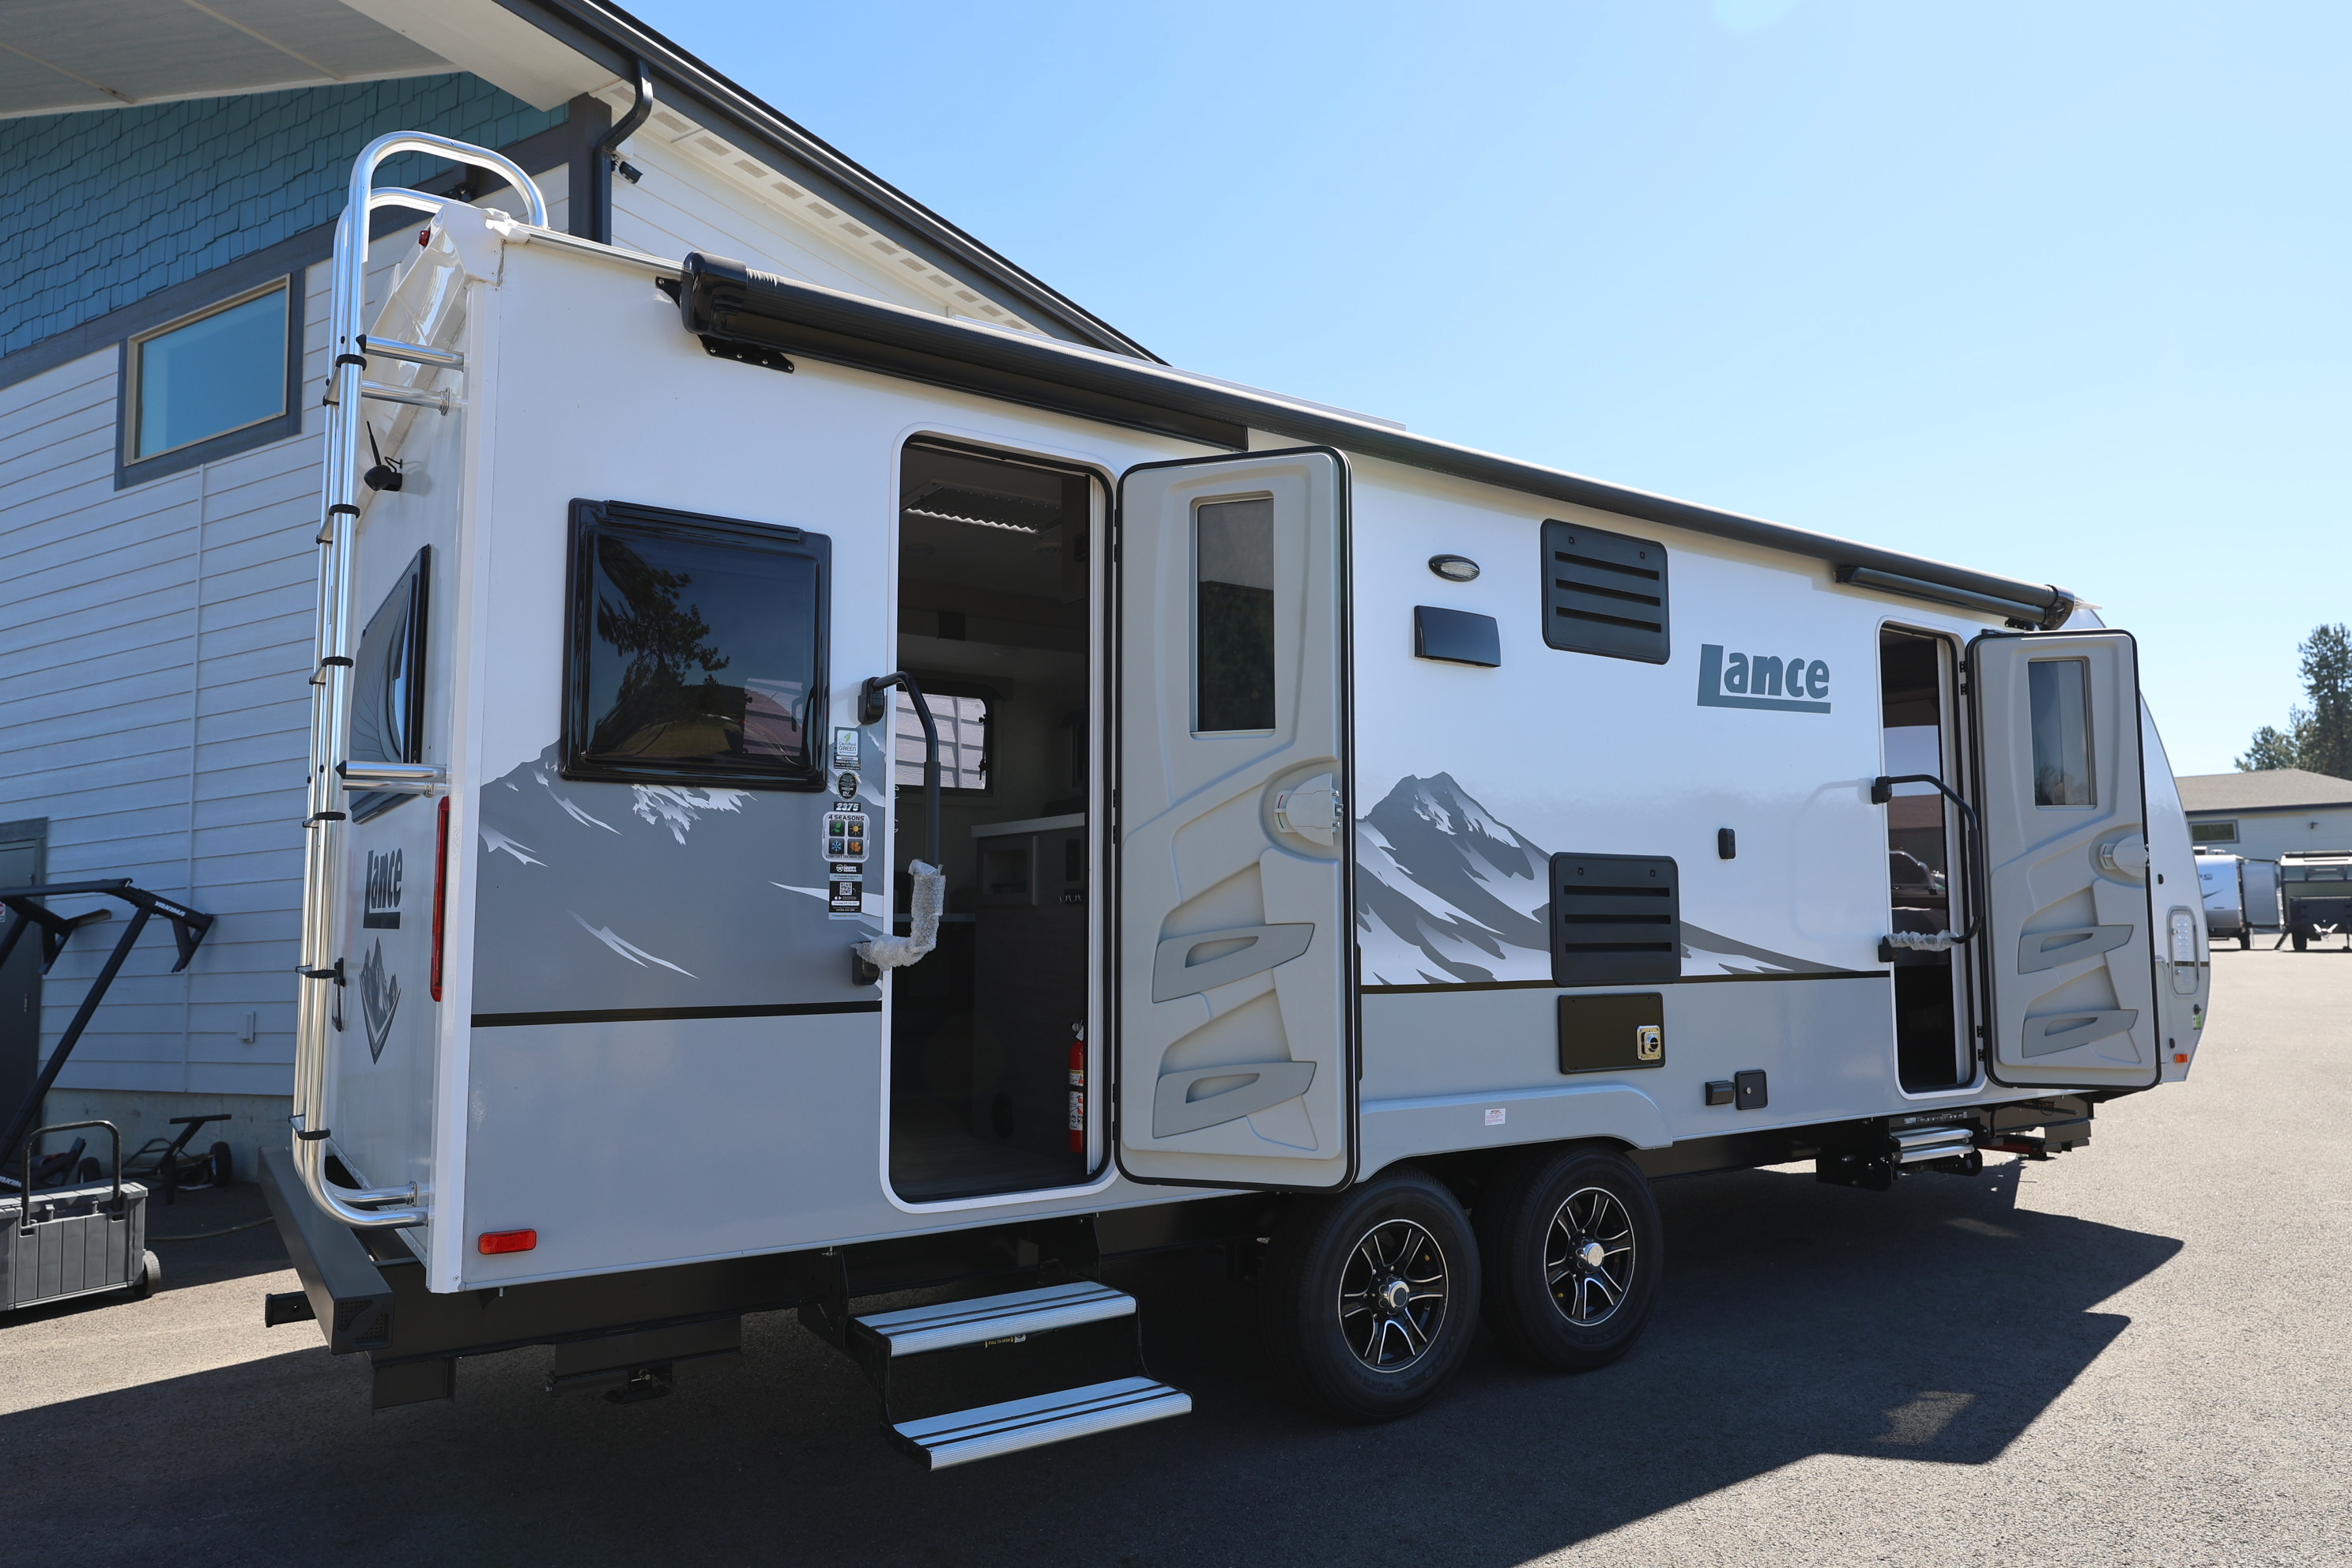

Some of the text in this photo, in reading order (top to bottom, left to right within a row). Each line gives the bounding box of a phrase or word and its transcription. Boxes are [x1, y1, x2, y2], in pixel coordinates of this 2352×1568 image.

[1697, 643, 1831, 714] Lance
[835, 802, 859, 811] 2375
[154, 900, 187, 917] YAKIMA
[363, 848, 403, 929] Lance
